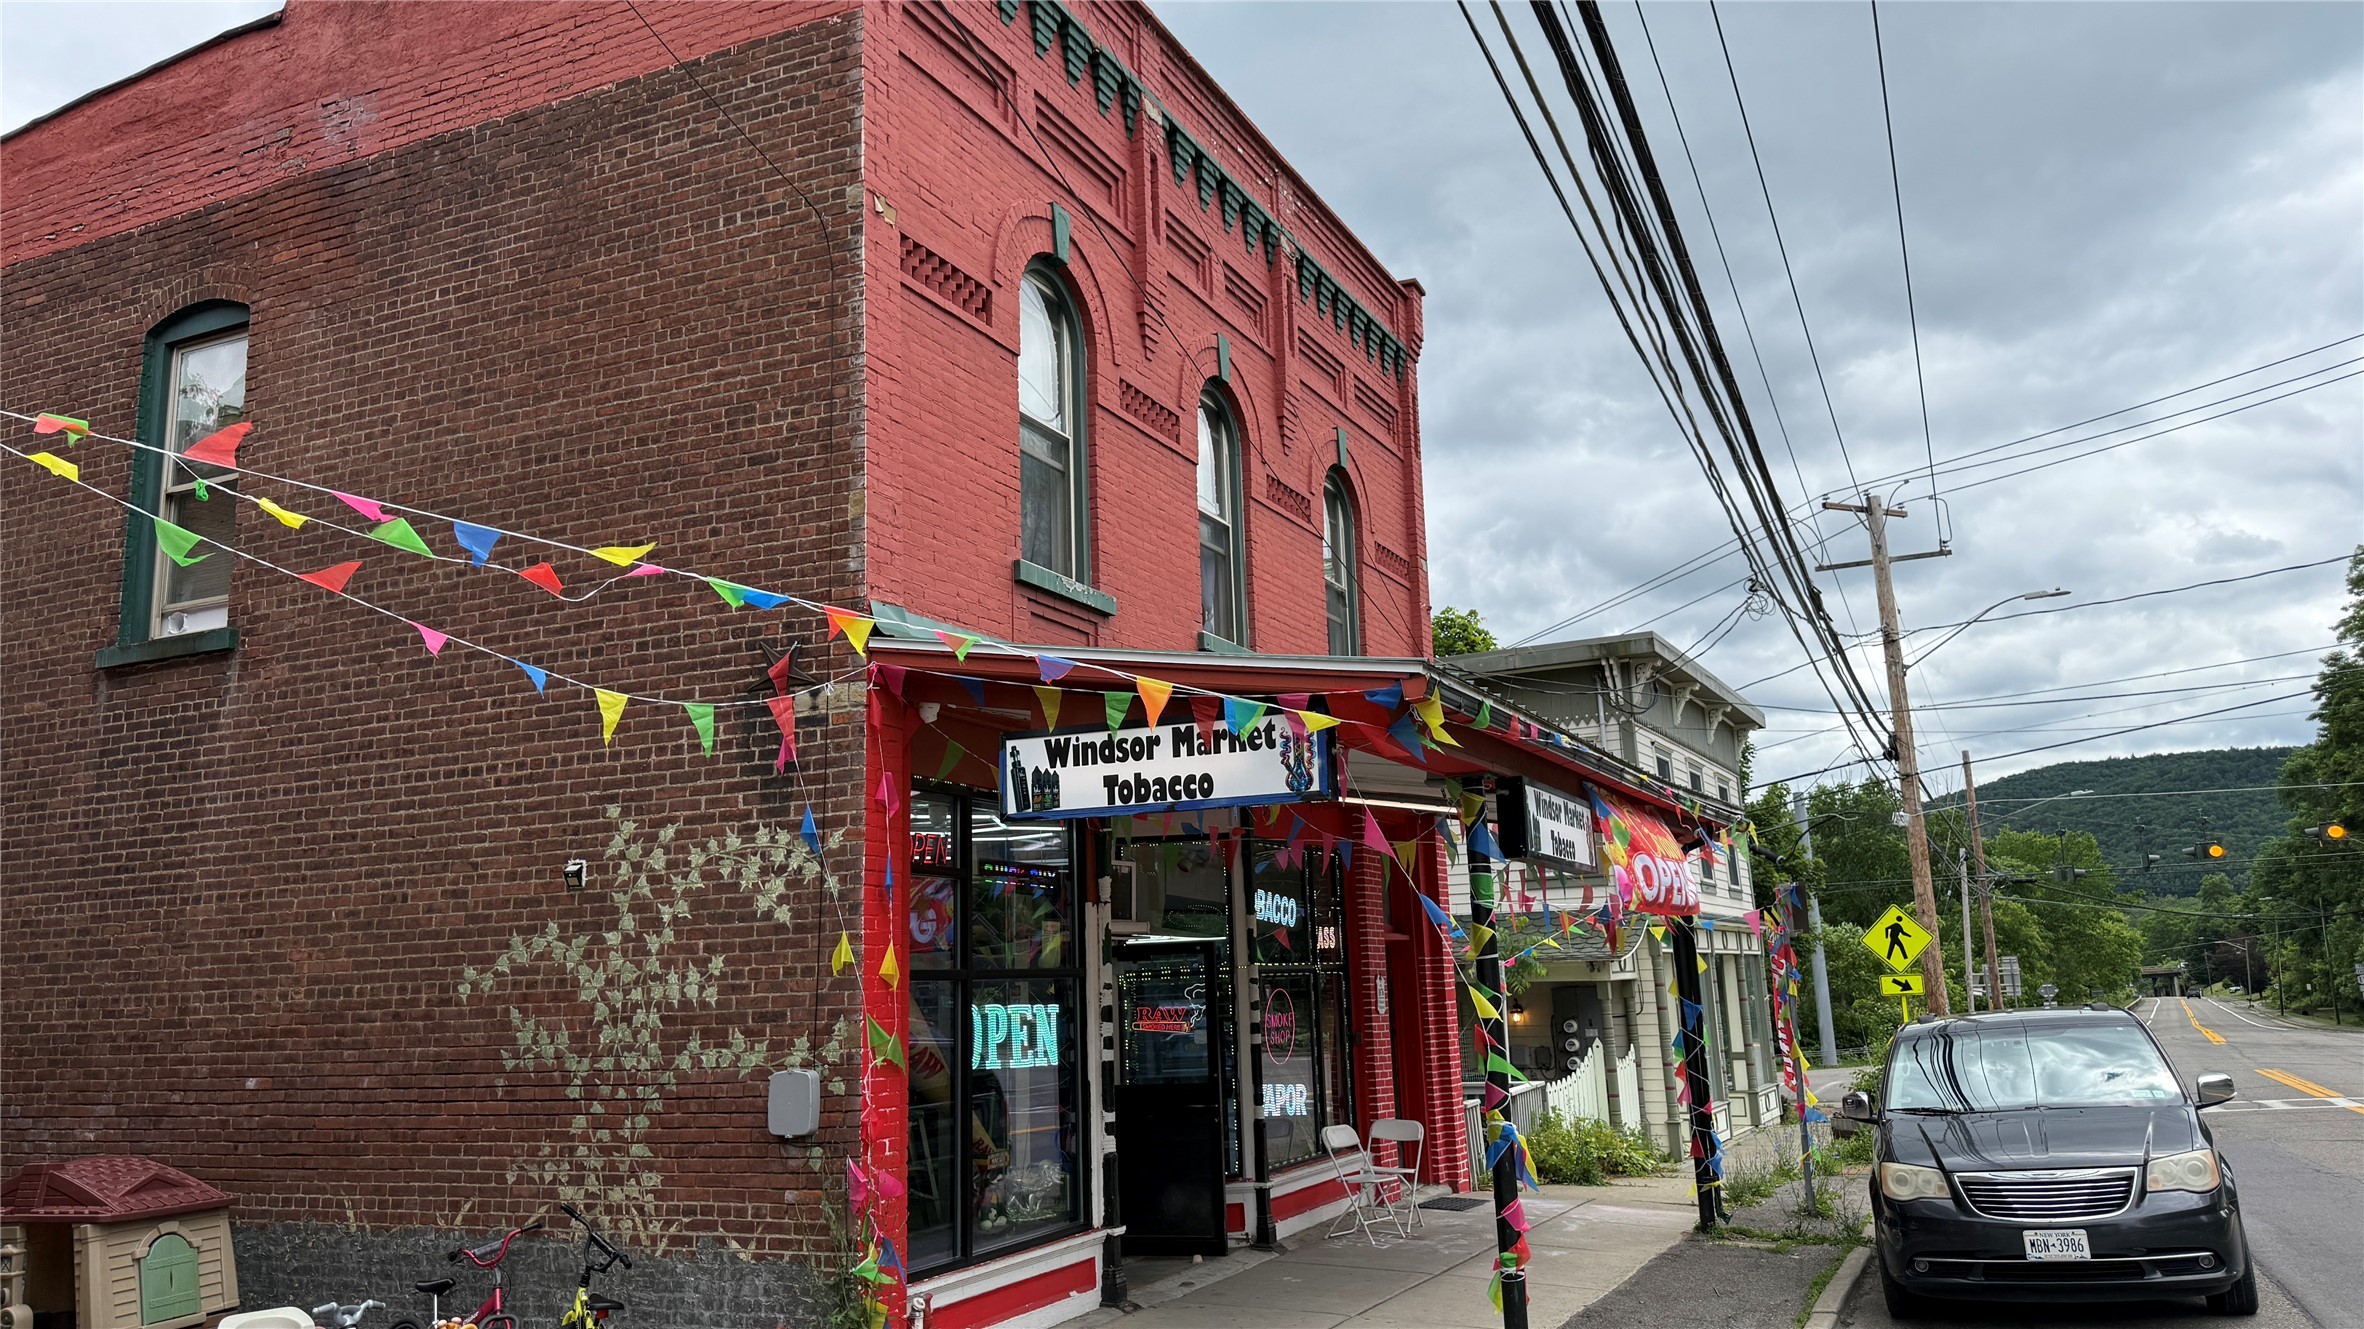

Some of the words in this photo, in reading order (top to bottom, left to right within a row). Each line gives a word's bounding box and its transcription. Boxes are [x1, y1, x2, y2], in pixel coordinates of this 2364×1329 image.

[1044, 733, 1161, 769] Windsor
[1103, 772, 1214, 805] Tobacco
[1533, 789, 1562, 824] Windsor
[1563, 800, 1585, 831] Market
[1550, 829, 1576, 860] Tobacco
[1255, 889, 1296, 927] BACCO
[1317, 927, 1335, 948] ASS
[1137, 1006, 1188, 1022] RAW
[1266, 1012, 1293, 1028] SMOKE
[1270, 1030, 1291, 1045] SHOP
[1262, 1084, 1307, 1117] APOR
